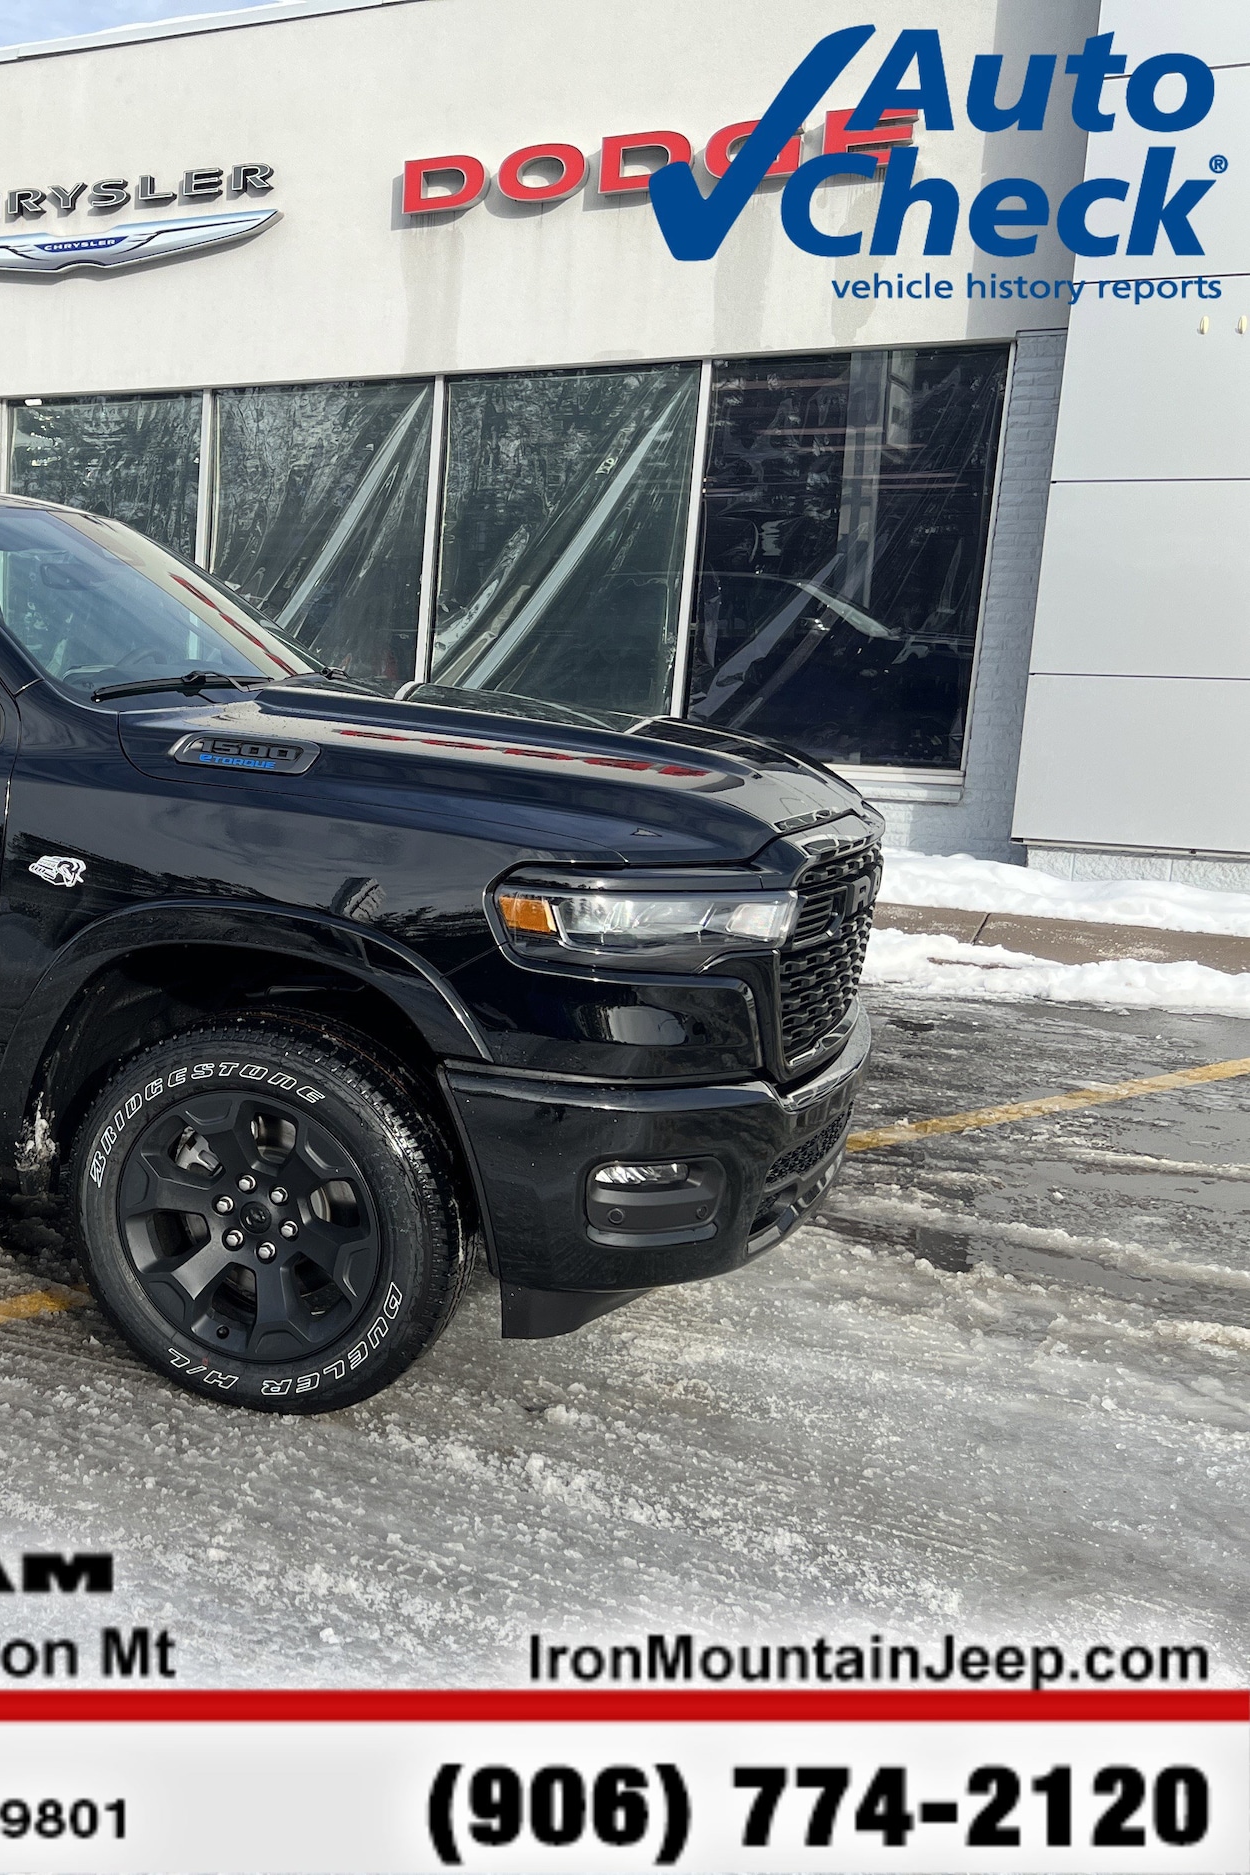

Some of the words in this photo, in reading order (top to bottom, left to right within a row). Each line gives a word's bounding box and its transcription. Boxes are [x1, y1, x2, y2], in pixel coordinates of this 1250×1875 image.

[44, 239, 116, 251] CHRYSLER
[197, 737, 299, 762] 1500
[89, 1062, 325, 1188] BRIDGESTONE
[261, 1281, 403, 1396] DUELER
[168, 1347, 239, 1390] H/L
